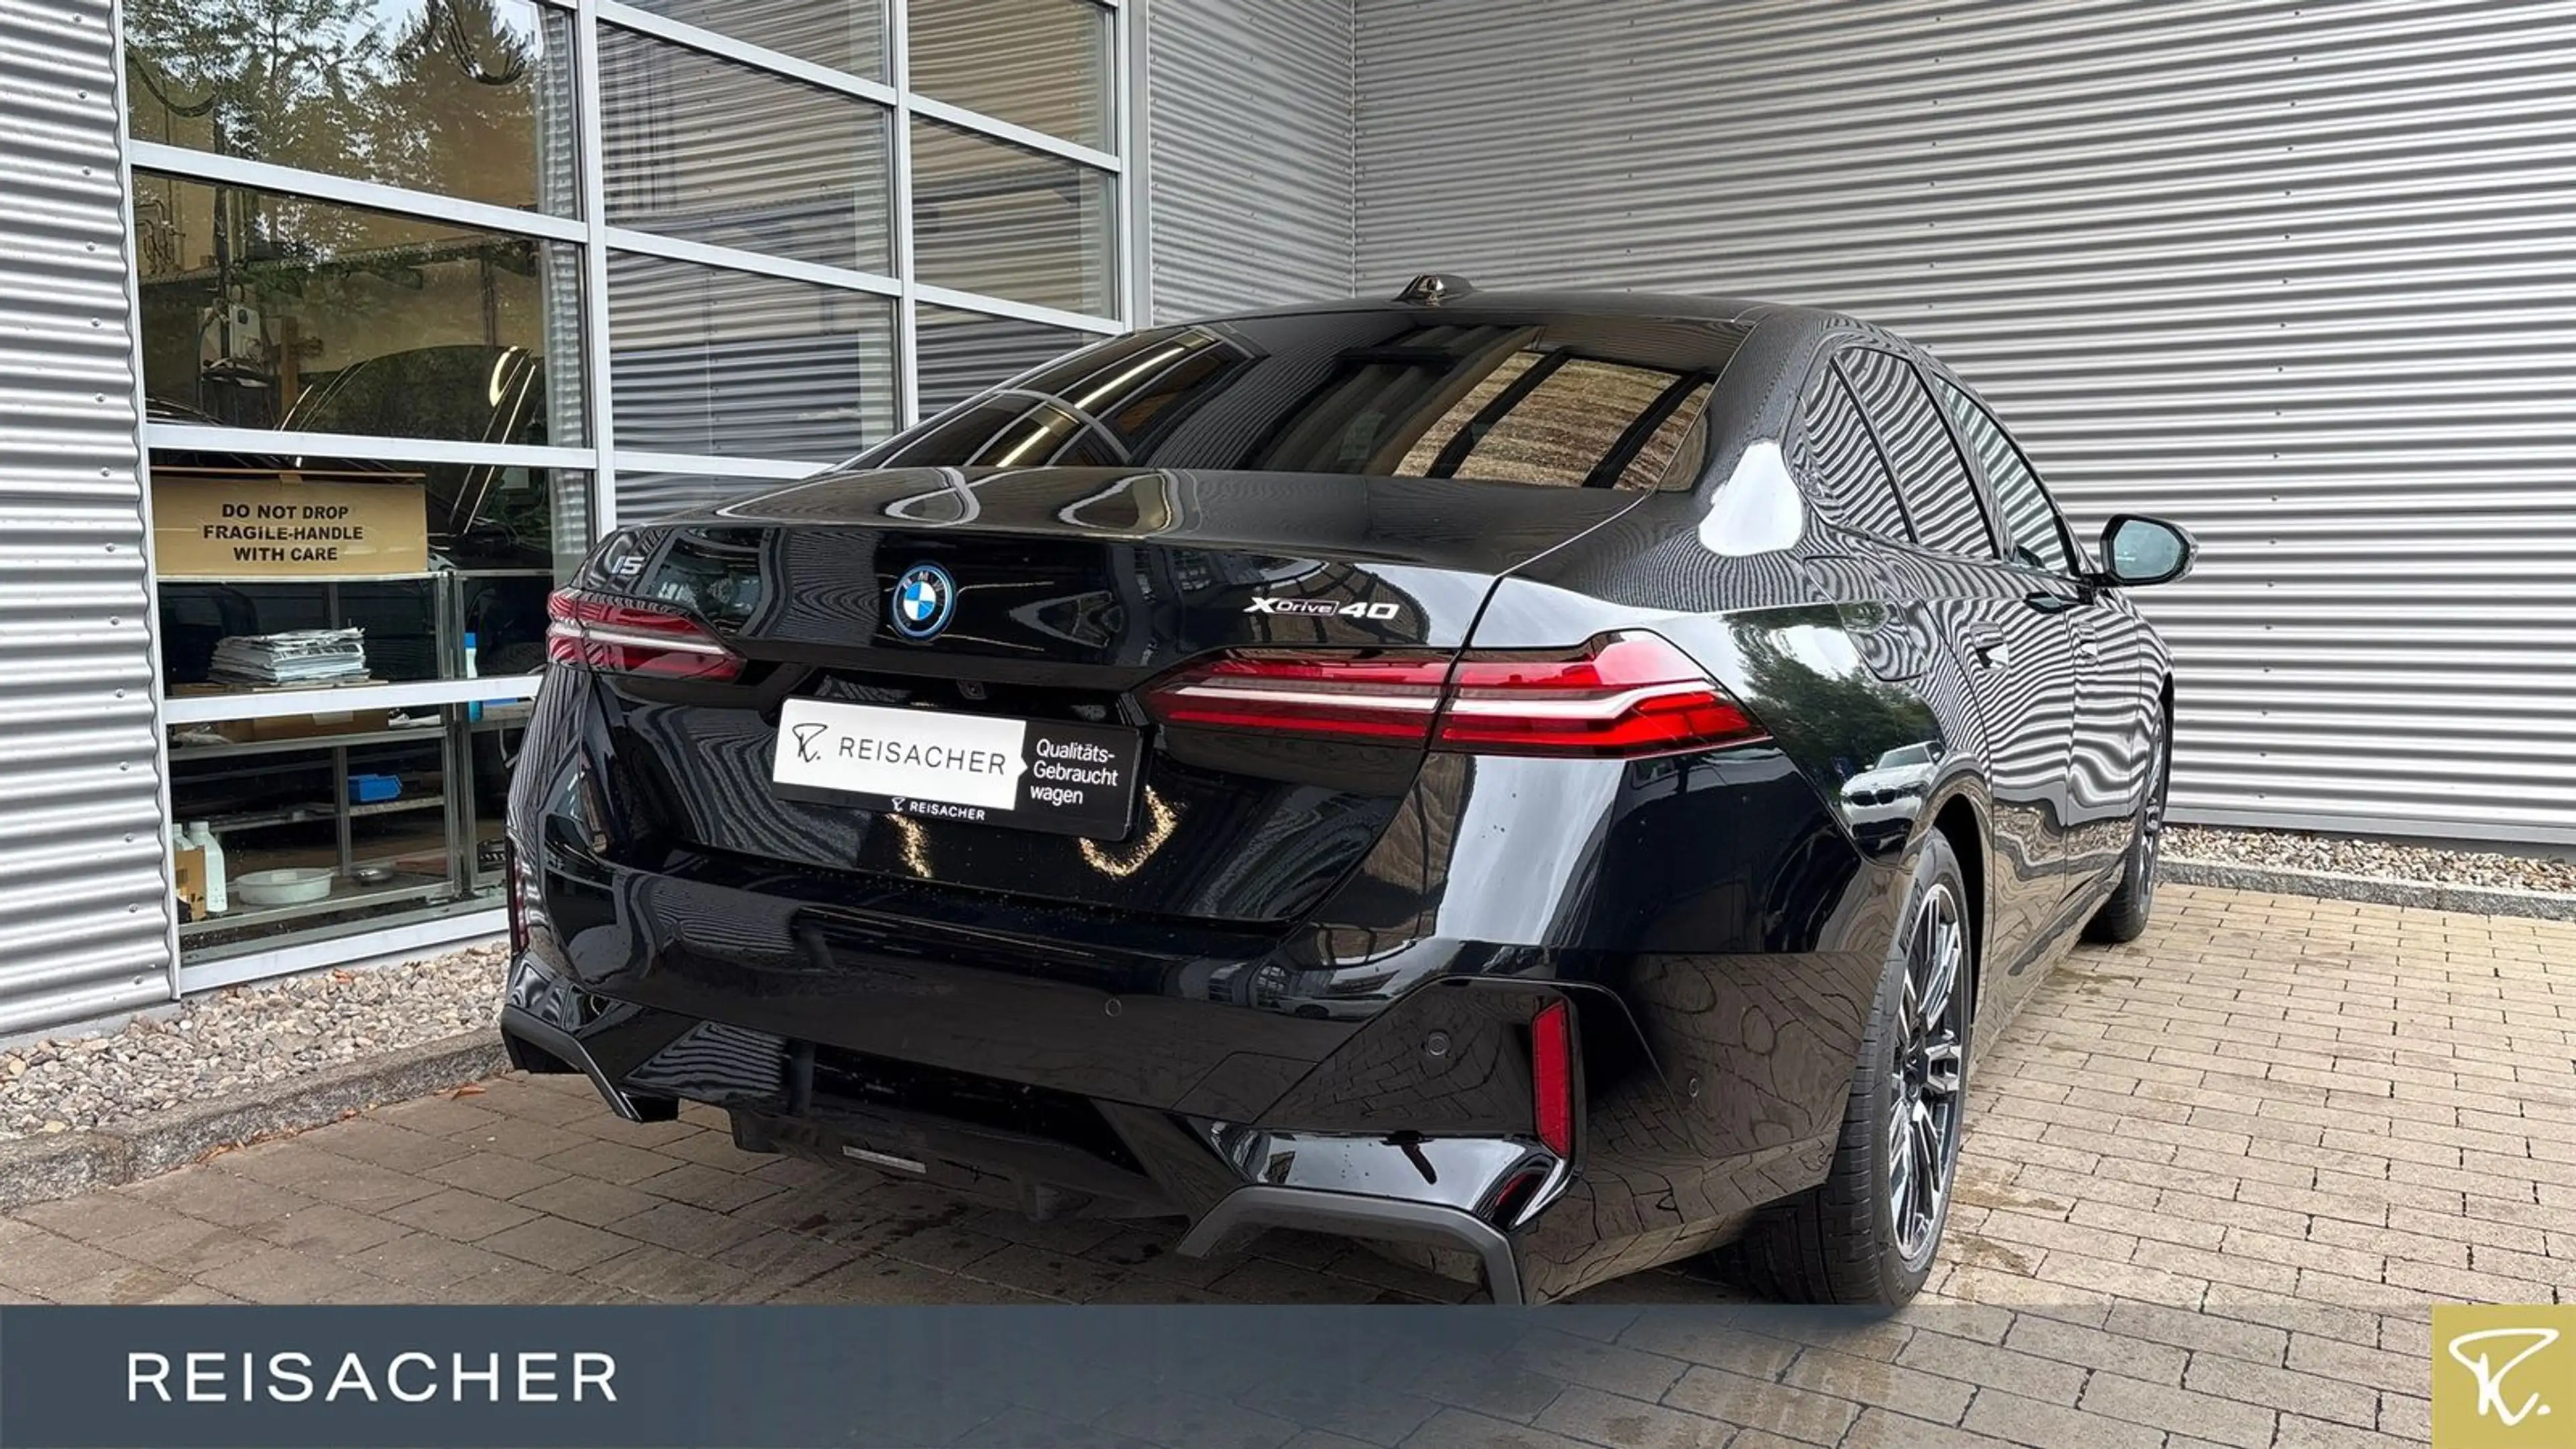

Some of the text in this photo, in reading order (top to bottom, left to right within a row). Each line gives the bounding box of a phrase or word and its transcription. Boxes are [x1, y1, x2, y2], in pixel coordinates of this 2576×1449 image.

[222, 504, 349, 520] DO NOT DROP
[203, 525, 364, 540] FRAGILE-HANDLE
[233, 547, 338, 561] WITH CARE
[839, 737, 1006, 775] REISACHER
[1036, 739, 1116, 763] Qualitäts-
[1033, 759, 1119, 787] Gebraucht
[1030, 786, 1083, 806] wagen
[909, 801, 985, 820] REISACHER
